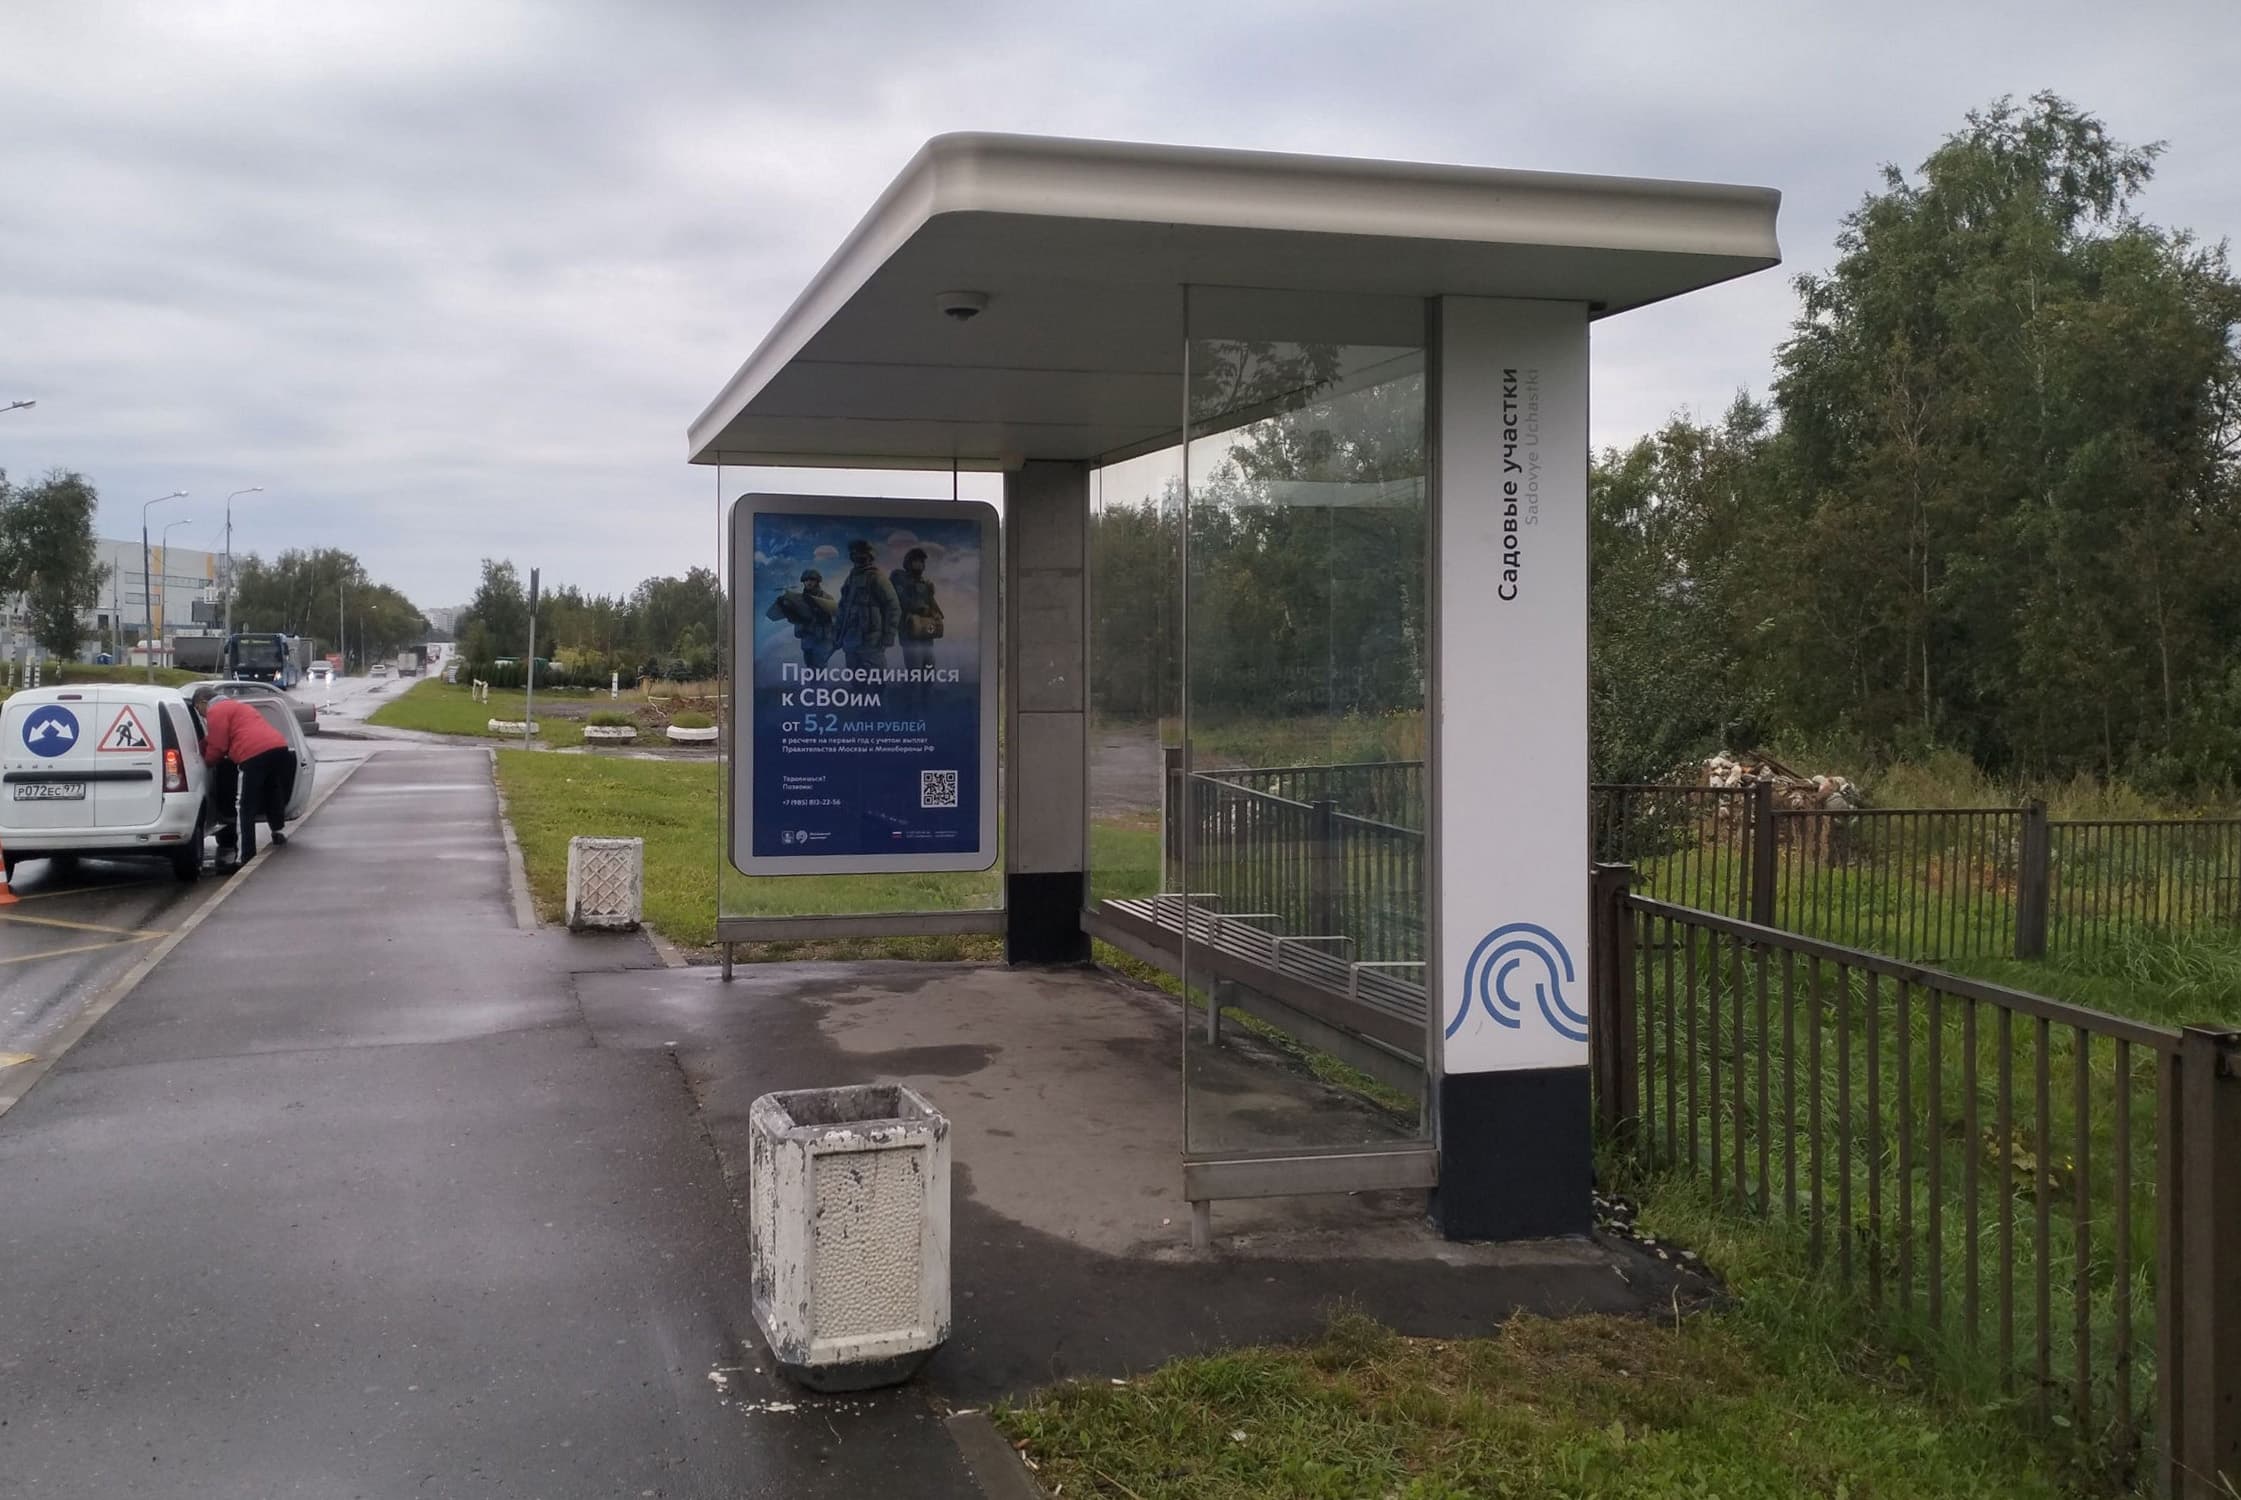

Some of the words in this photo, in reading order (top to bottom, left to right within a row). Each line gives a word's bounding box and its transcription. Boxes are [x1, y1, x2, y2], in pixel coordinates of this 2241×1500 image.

[1503, 368, 1522, 474] участки
[1525, 368, 1539, 446] Uchastki
[1525, 452, 1542, 526] Sadovye
[1498, 480, 1520, 601] Садовые
[782, 663, 960, 685] Присоединяйся
[782, 693, 794, 706] к
[800, 688, 881, 707] СВОим
[782, 721, 800, 732] от
[804, 714, 838, 734] 5,2
[843, 721, 873, 732] МЛН
[877, 720, 926, 732] РУБЛЕЙ
[63, 785, 81, 793] 977
